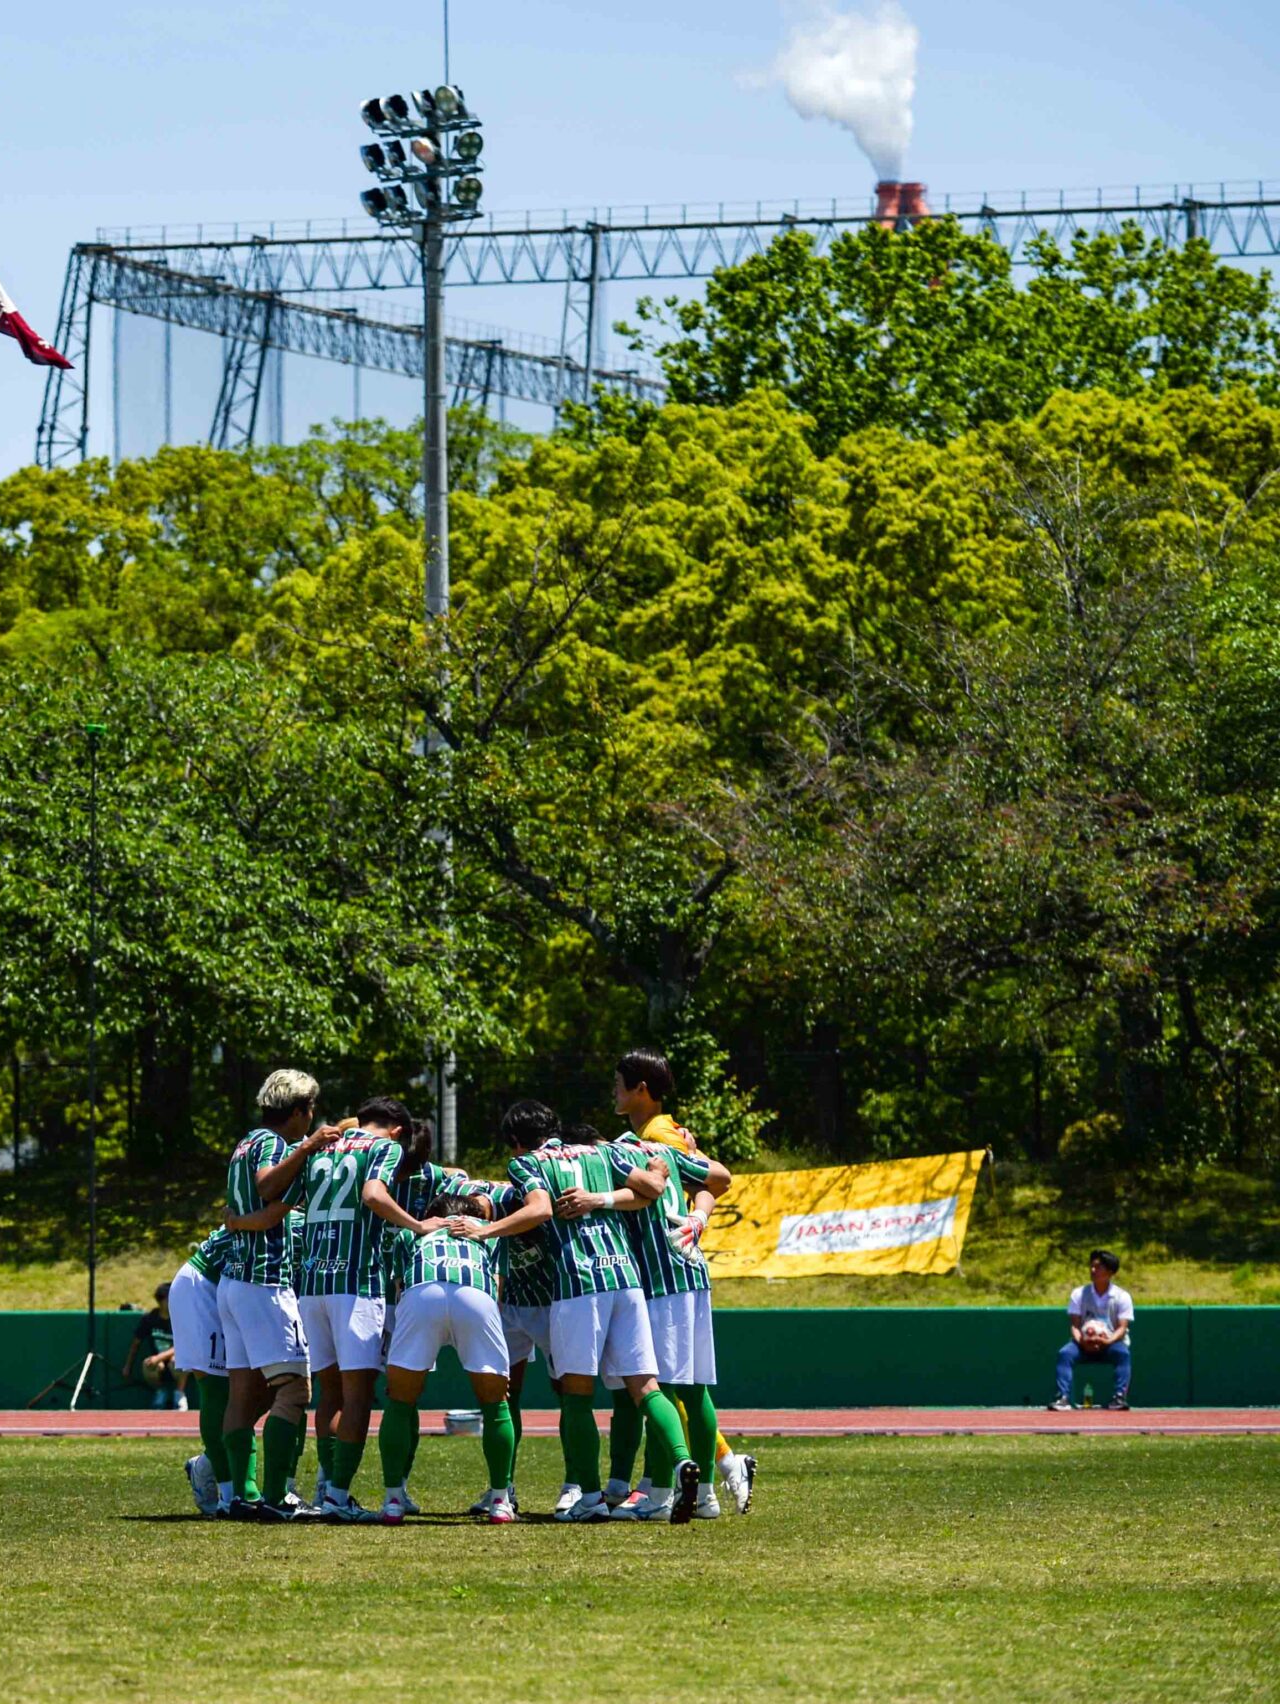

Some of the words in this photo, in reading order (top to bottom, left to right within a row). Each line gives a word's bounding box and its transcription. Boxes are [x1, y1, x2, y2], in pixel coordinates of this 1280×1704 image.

[307, 1154, 358, 1223] 22
[795, 1221, 864, 1241] JAPAN
[869, 1211, 941, 1231] SPORT
